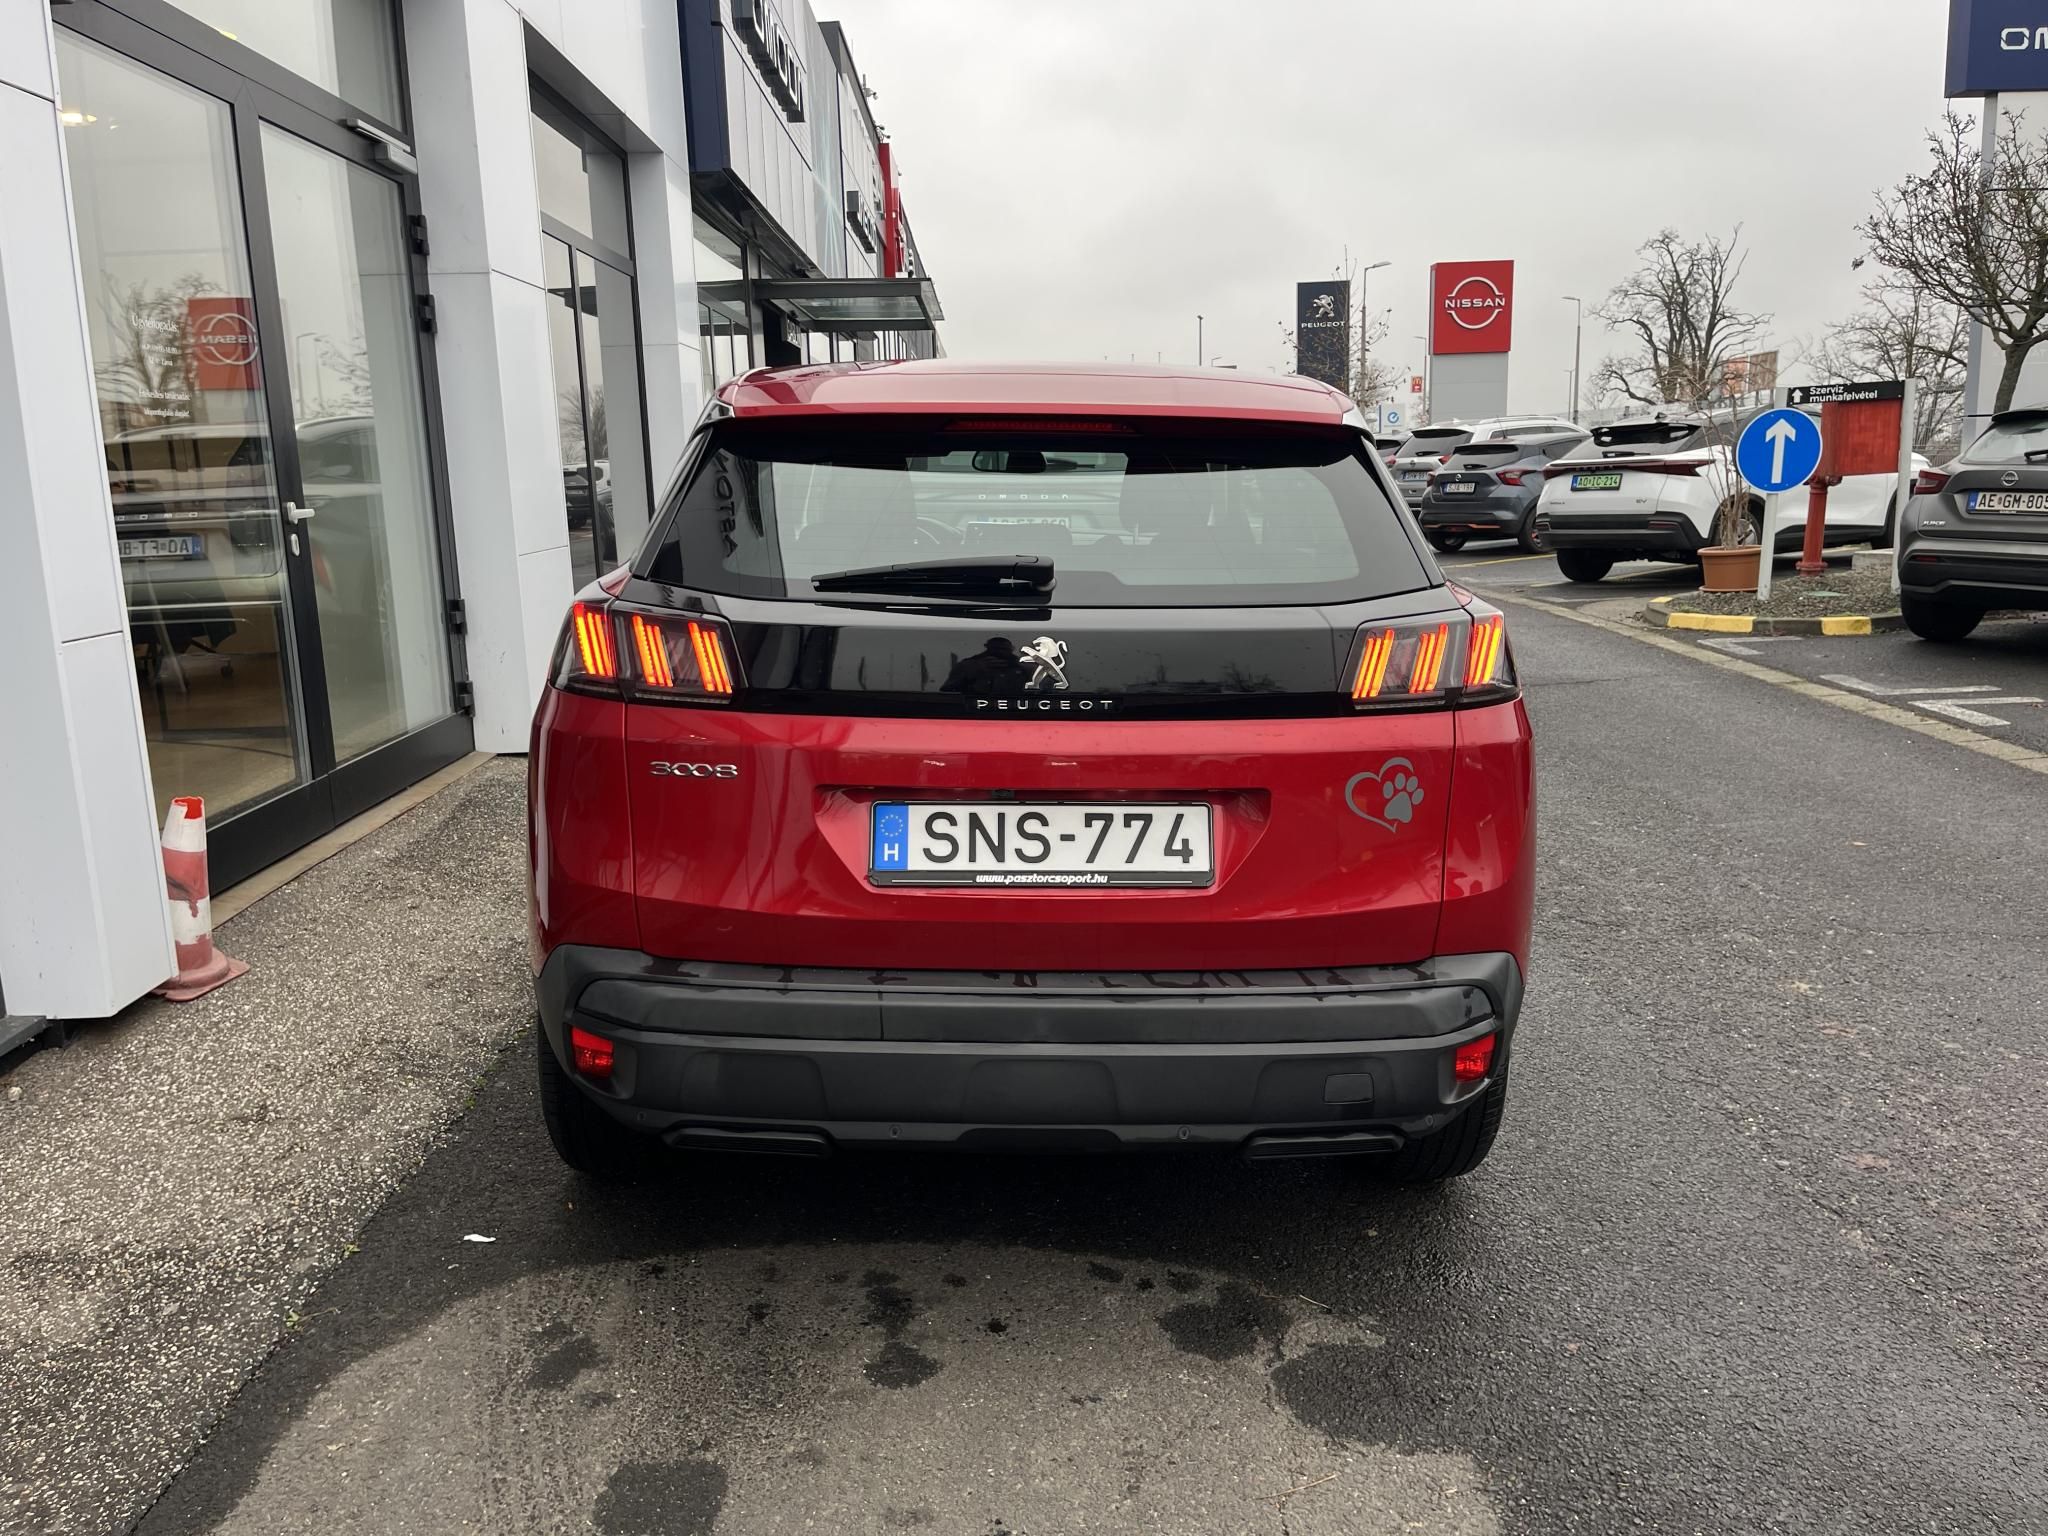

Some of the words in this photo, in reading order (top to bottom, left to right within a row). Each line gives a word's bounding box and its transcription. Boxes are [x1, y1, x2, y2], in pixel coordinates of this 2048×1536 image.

[1444, 297, 1506, 308] NISSAN
[1301, 321, 1346, 329] PEUGEOT
[1809, 386, 1845, 395] Szerviz
[1809, 390, 1878, 403] munkafelvétel
[1978, 493, 1996, 508] AE
[977, 700, 1112, 710] PEUGEOT
[650, 761, 738, 778] 3008
[922, 811, 1194, 864] SNS-774
[883, 843, 899, 861] H
[975, 873, 1108, 885] www.pasztorcsoport.hu
